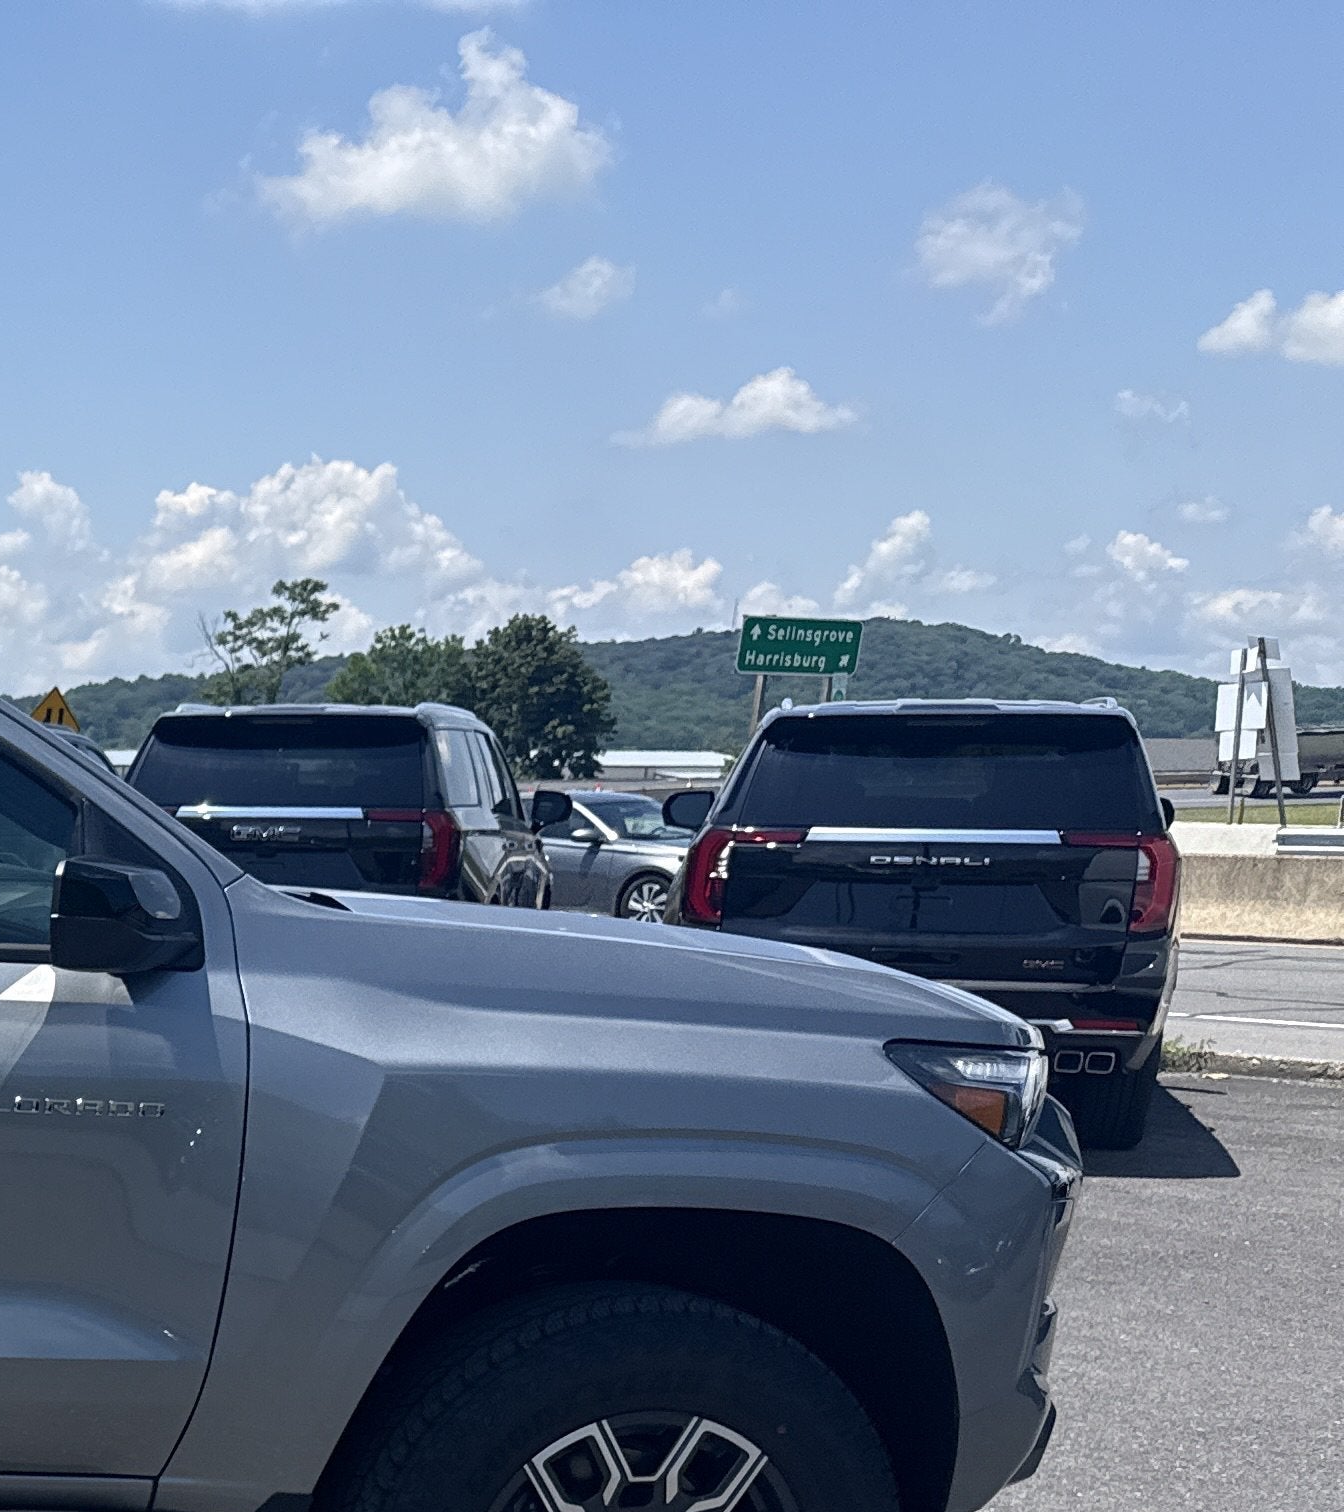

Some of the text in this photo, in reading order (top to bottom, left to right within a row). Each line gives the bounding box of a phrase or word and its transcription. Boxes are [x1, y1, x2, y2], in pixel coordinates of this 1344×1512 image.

[767, 624, 854, 646] Selinsgrove
[745, 650, 826, 672] Harrisburg
[870, 856, 991, 866] DENALI
